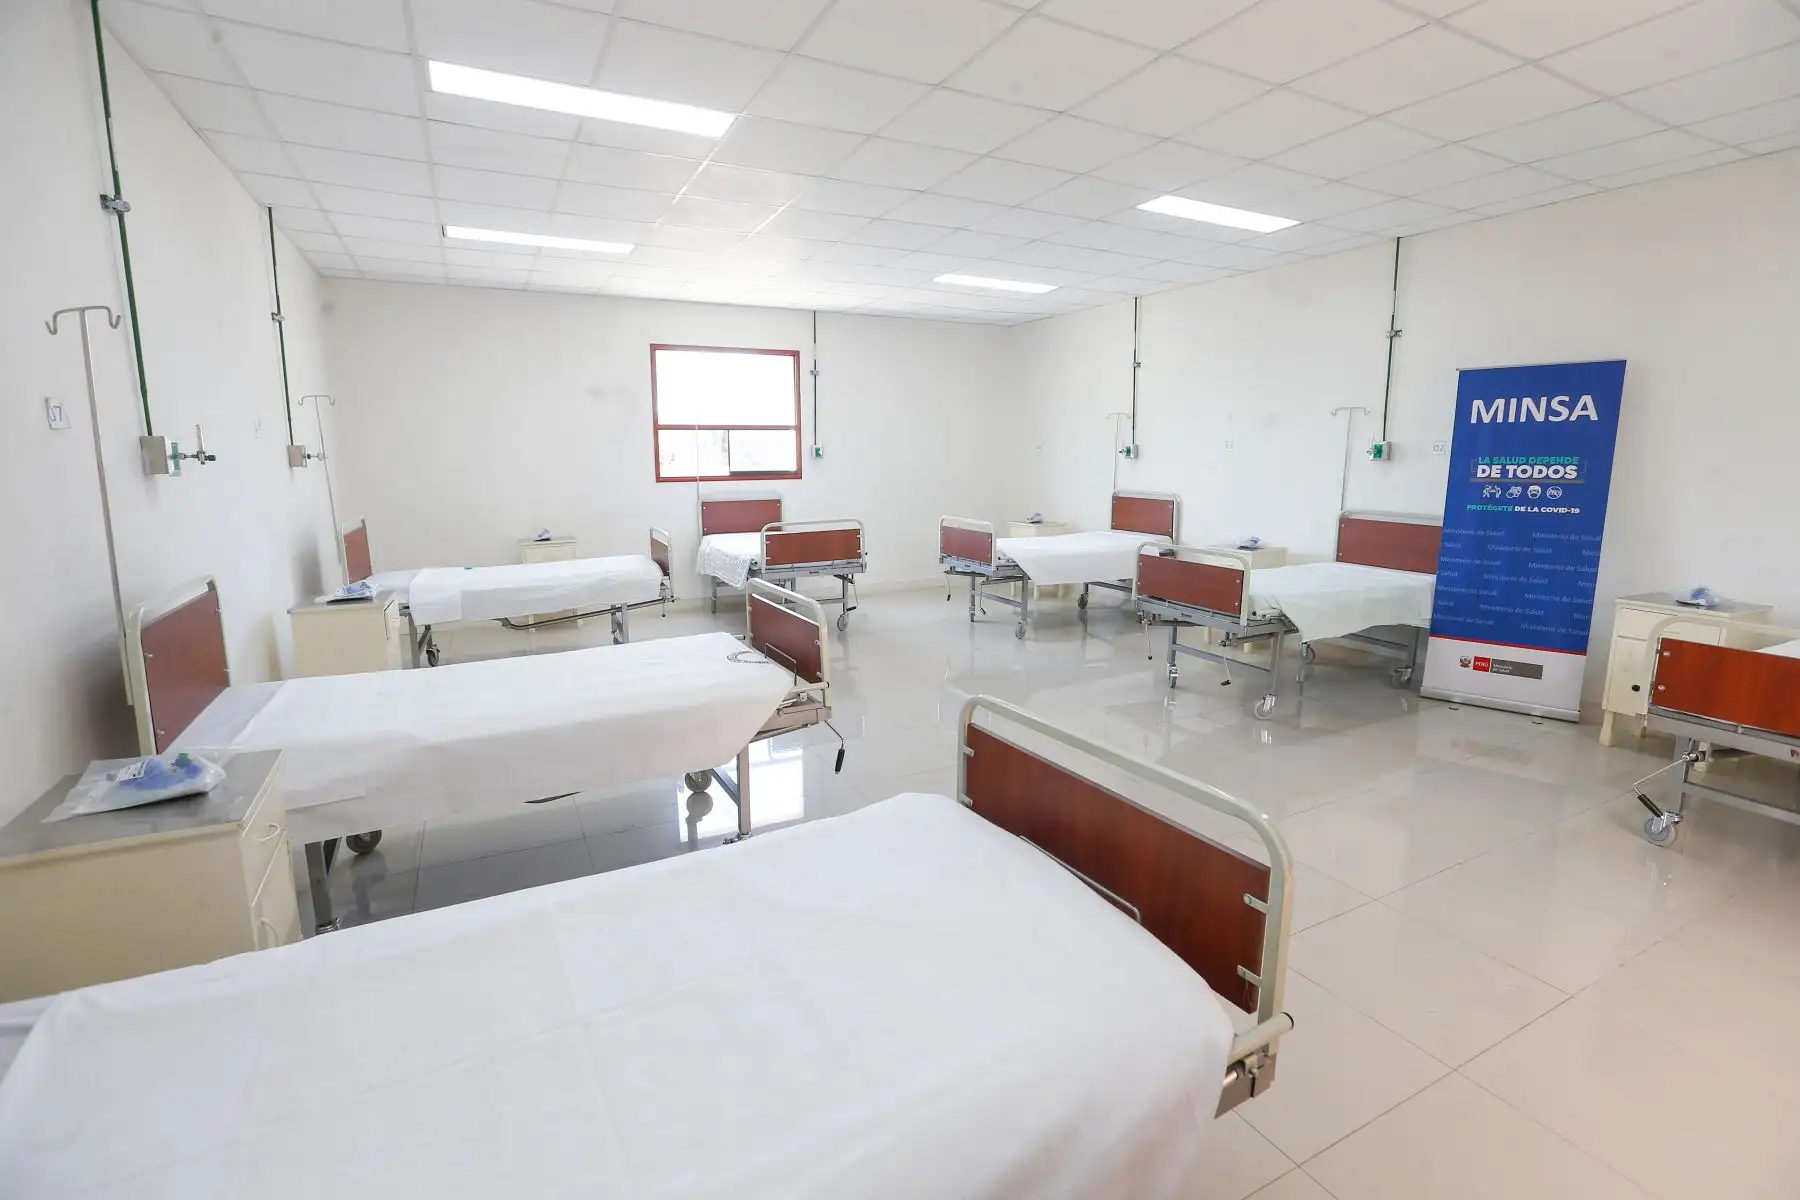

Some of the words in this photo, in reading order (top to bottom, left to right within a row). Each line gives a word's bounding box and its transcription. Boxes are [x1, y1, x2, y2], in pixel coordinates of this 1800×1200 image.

[1470, 394, 1598, 424] MINSA
[1478, 456, 1490, 464] LA
[1492, 456, 1526, 464] SALUD
[1476, 465, 1502, 478] DE
[1506, 465, 1578, 480] TODOS
[1540, 506, 1580, 514] COVID-19
